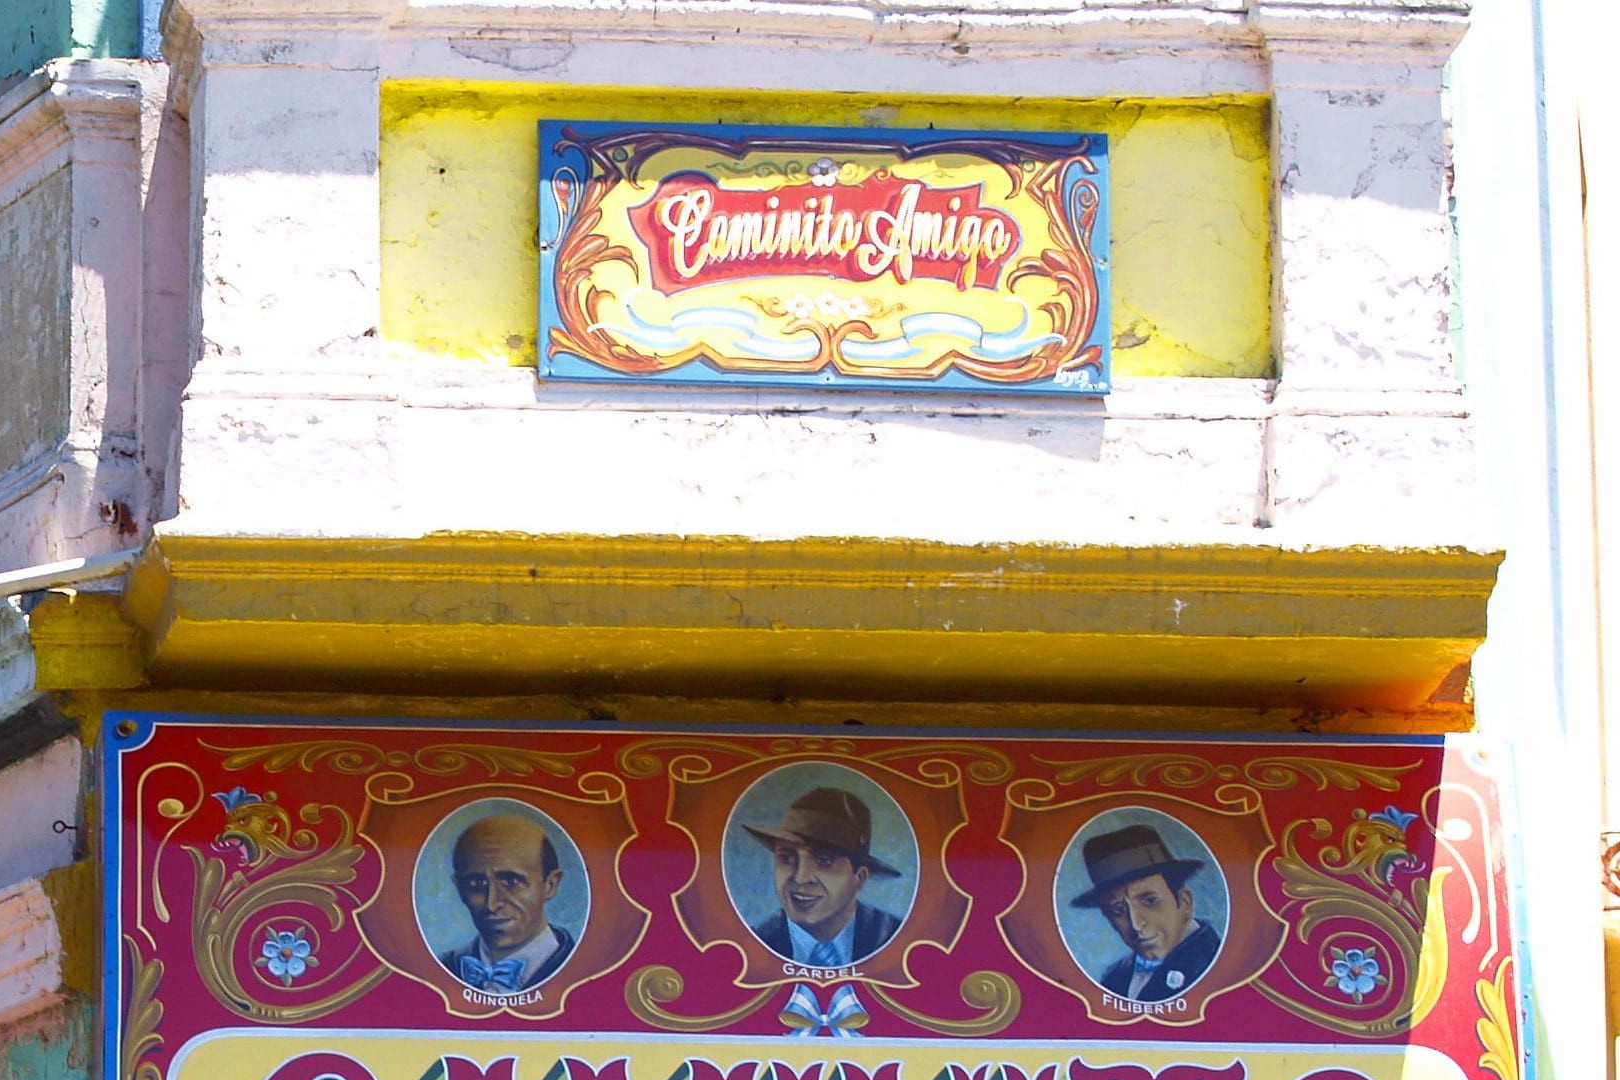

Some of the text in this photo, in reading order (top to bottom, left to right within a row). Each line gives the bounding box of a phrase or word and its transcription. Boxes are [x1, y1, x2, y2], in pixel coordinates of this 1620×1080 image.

[661, 182, 1012, 288] Caminito Amigo
[782, 962, 865, 979] GARDEL
[463, 988, 543, 1007] QUINQUELA
[1102, 993, 1187, 1014] FILIBERTO
